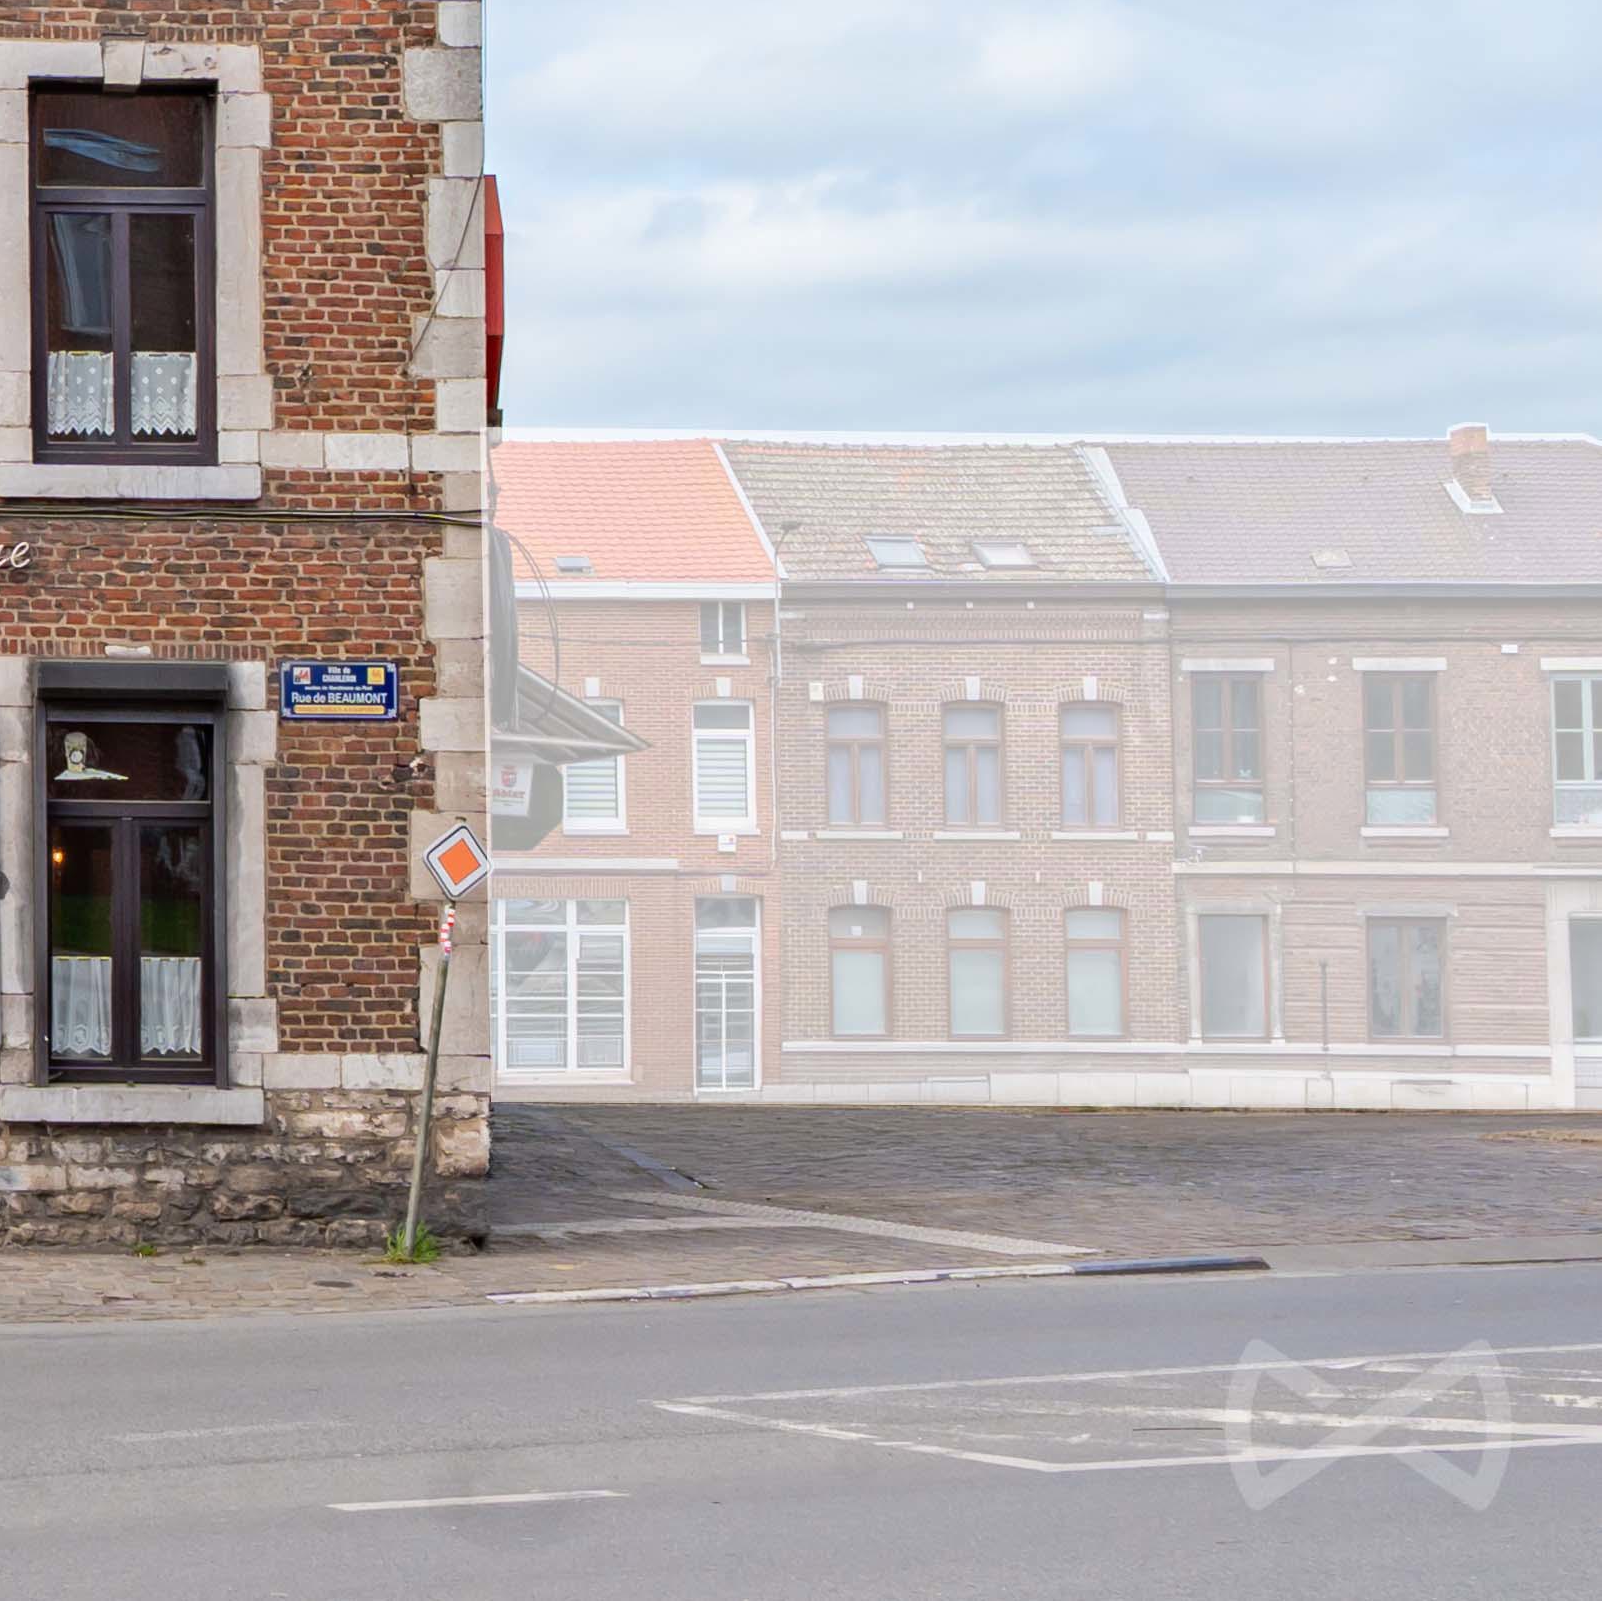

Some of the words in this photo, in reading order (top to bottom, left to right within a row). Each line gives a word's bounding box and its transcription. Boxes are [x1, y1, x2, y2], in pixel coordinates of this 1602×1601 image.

[291, 692, 312, 704] Rue
[313, 692, 327, 704] de
[328, 692, 388, 704] BEAUMONT
